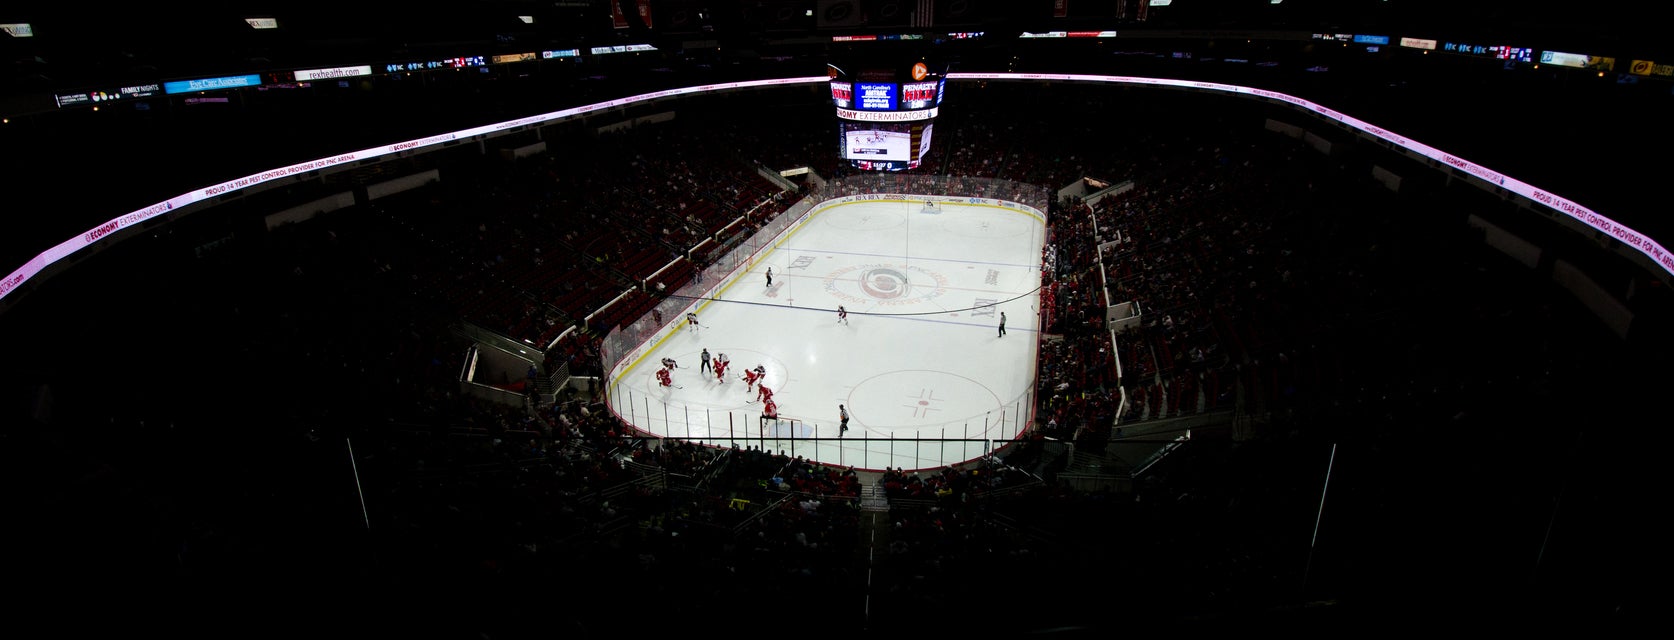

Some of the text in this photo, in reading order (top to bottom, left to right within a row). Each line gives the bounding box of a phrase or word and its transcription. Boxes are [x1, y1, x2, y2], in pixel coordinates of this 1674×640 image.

[309, 68, 360, 79] rexhealth.com
[201, 79, 216, 88] Care
[216, 76, 248, 87] Associates
[903, 82, 937, 92] PENALTY
[121, 84, 160, 95] FAMILY NIGHTS
[903, 89, 932, 102] KILL
[860, 112, 926, 121] EXTERMINATORS
[393, 142, 419, 151] ECONOMY
[1446, 155, 1468, 169] ECONOMY
[205, 185, 226, 197] PROUD
[227, 183, 234, 191] 14
[235, 179, 249, 189] YEAR
[249, 176, 261, 185] PEST
[261, 169, 287, 181] CONTROL
[287, 163, 314, 174] PROVIDER
[326, 158, 337, 166] PNC
[337, 155, 355, 164] ARENA
[90, 203, 167, 241] ECONOMY EXTERMINATORS
[1533, 190, 1551, 204] PROUD
[1552, 198, 1560, 206] 14
[1561, 201, 1575, 214] YEAR
[1575, 208, 1587, 219] PEST
[1587, 214, 1611, 232] CONTROL
[1612, 226, 1642, 246] PROVIDER
[1642, 240, 1653, 254] FOR
[1652, 247, 1663, 261] PNC
